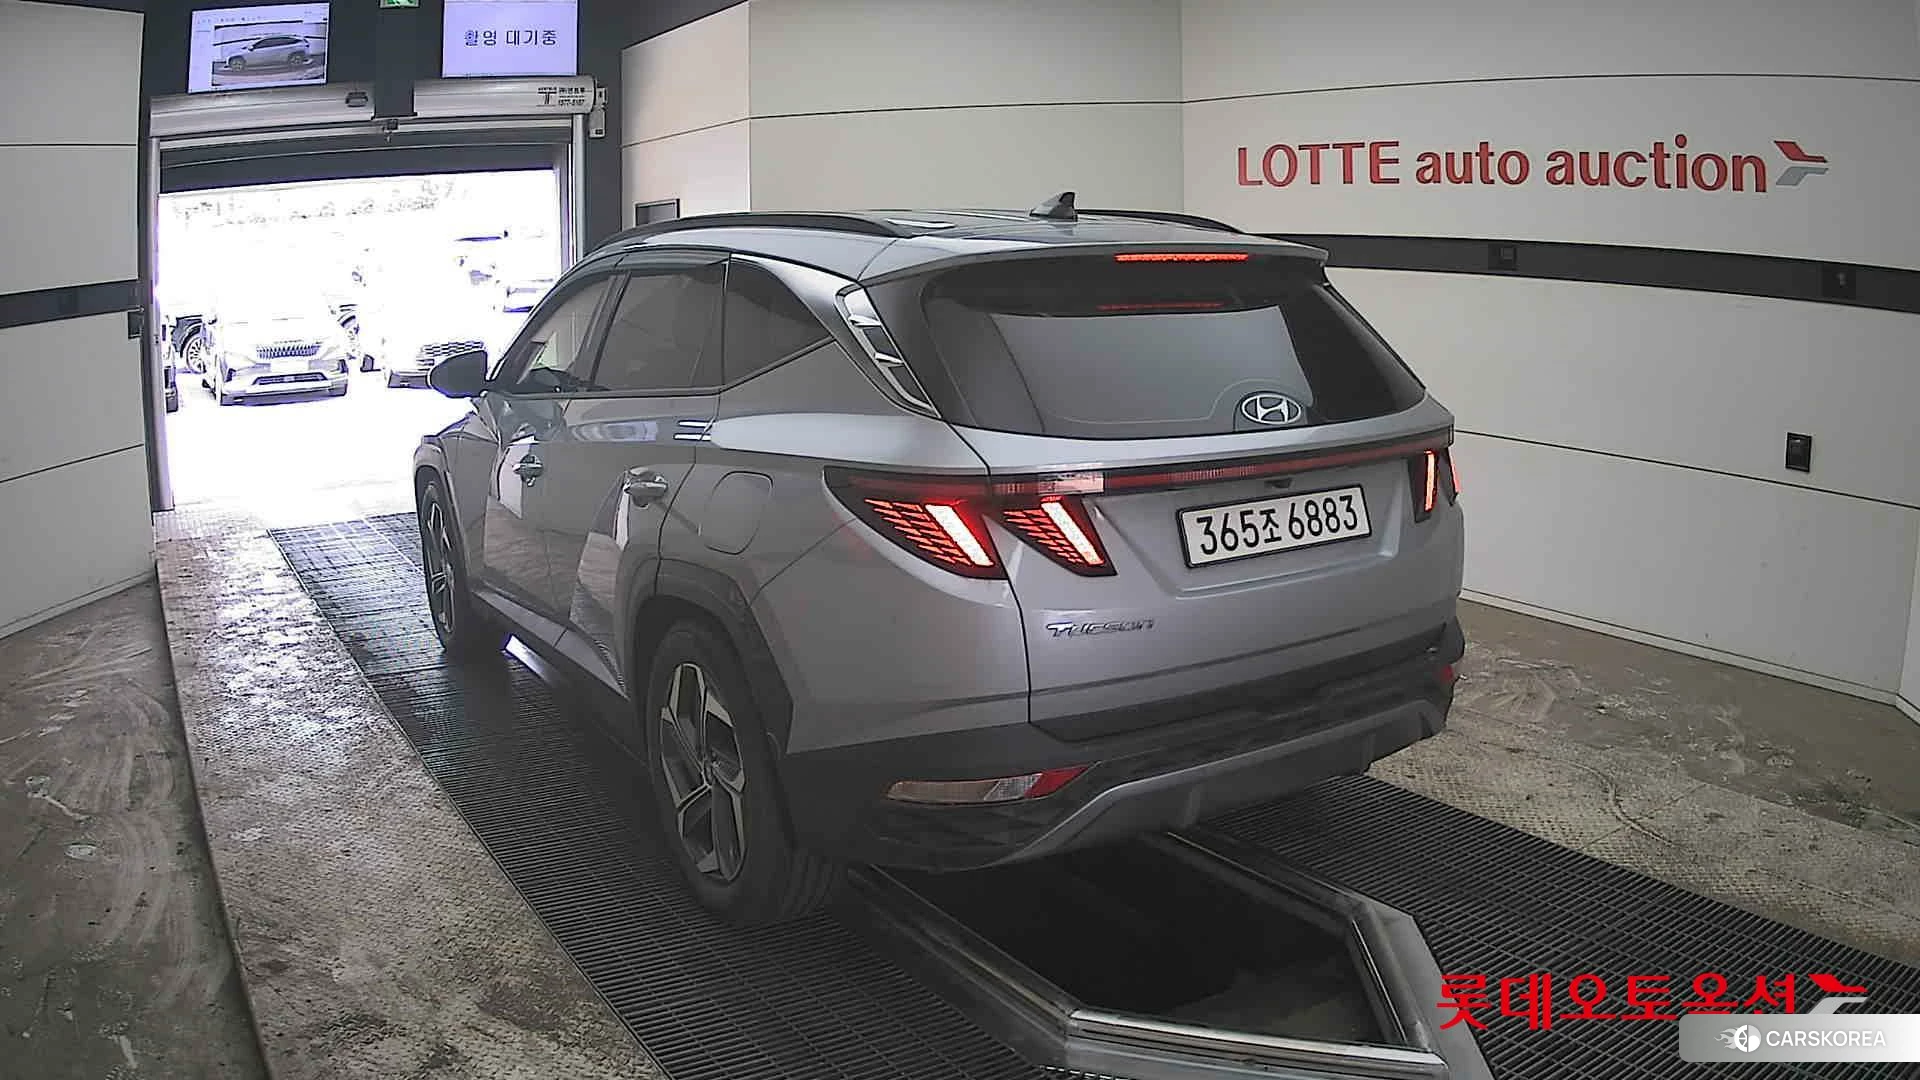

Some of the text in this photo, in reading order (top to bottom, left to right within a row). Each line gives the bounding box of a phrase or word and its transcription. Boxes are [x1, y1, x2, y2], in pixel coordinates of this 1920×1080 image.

[505, 30, 557, 46] 대기중
[1237, 134, 1767, 193] LOTTE auto auction
[1196, 495, 1358, 555] 365조 6883
